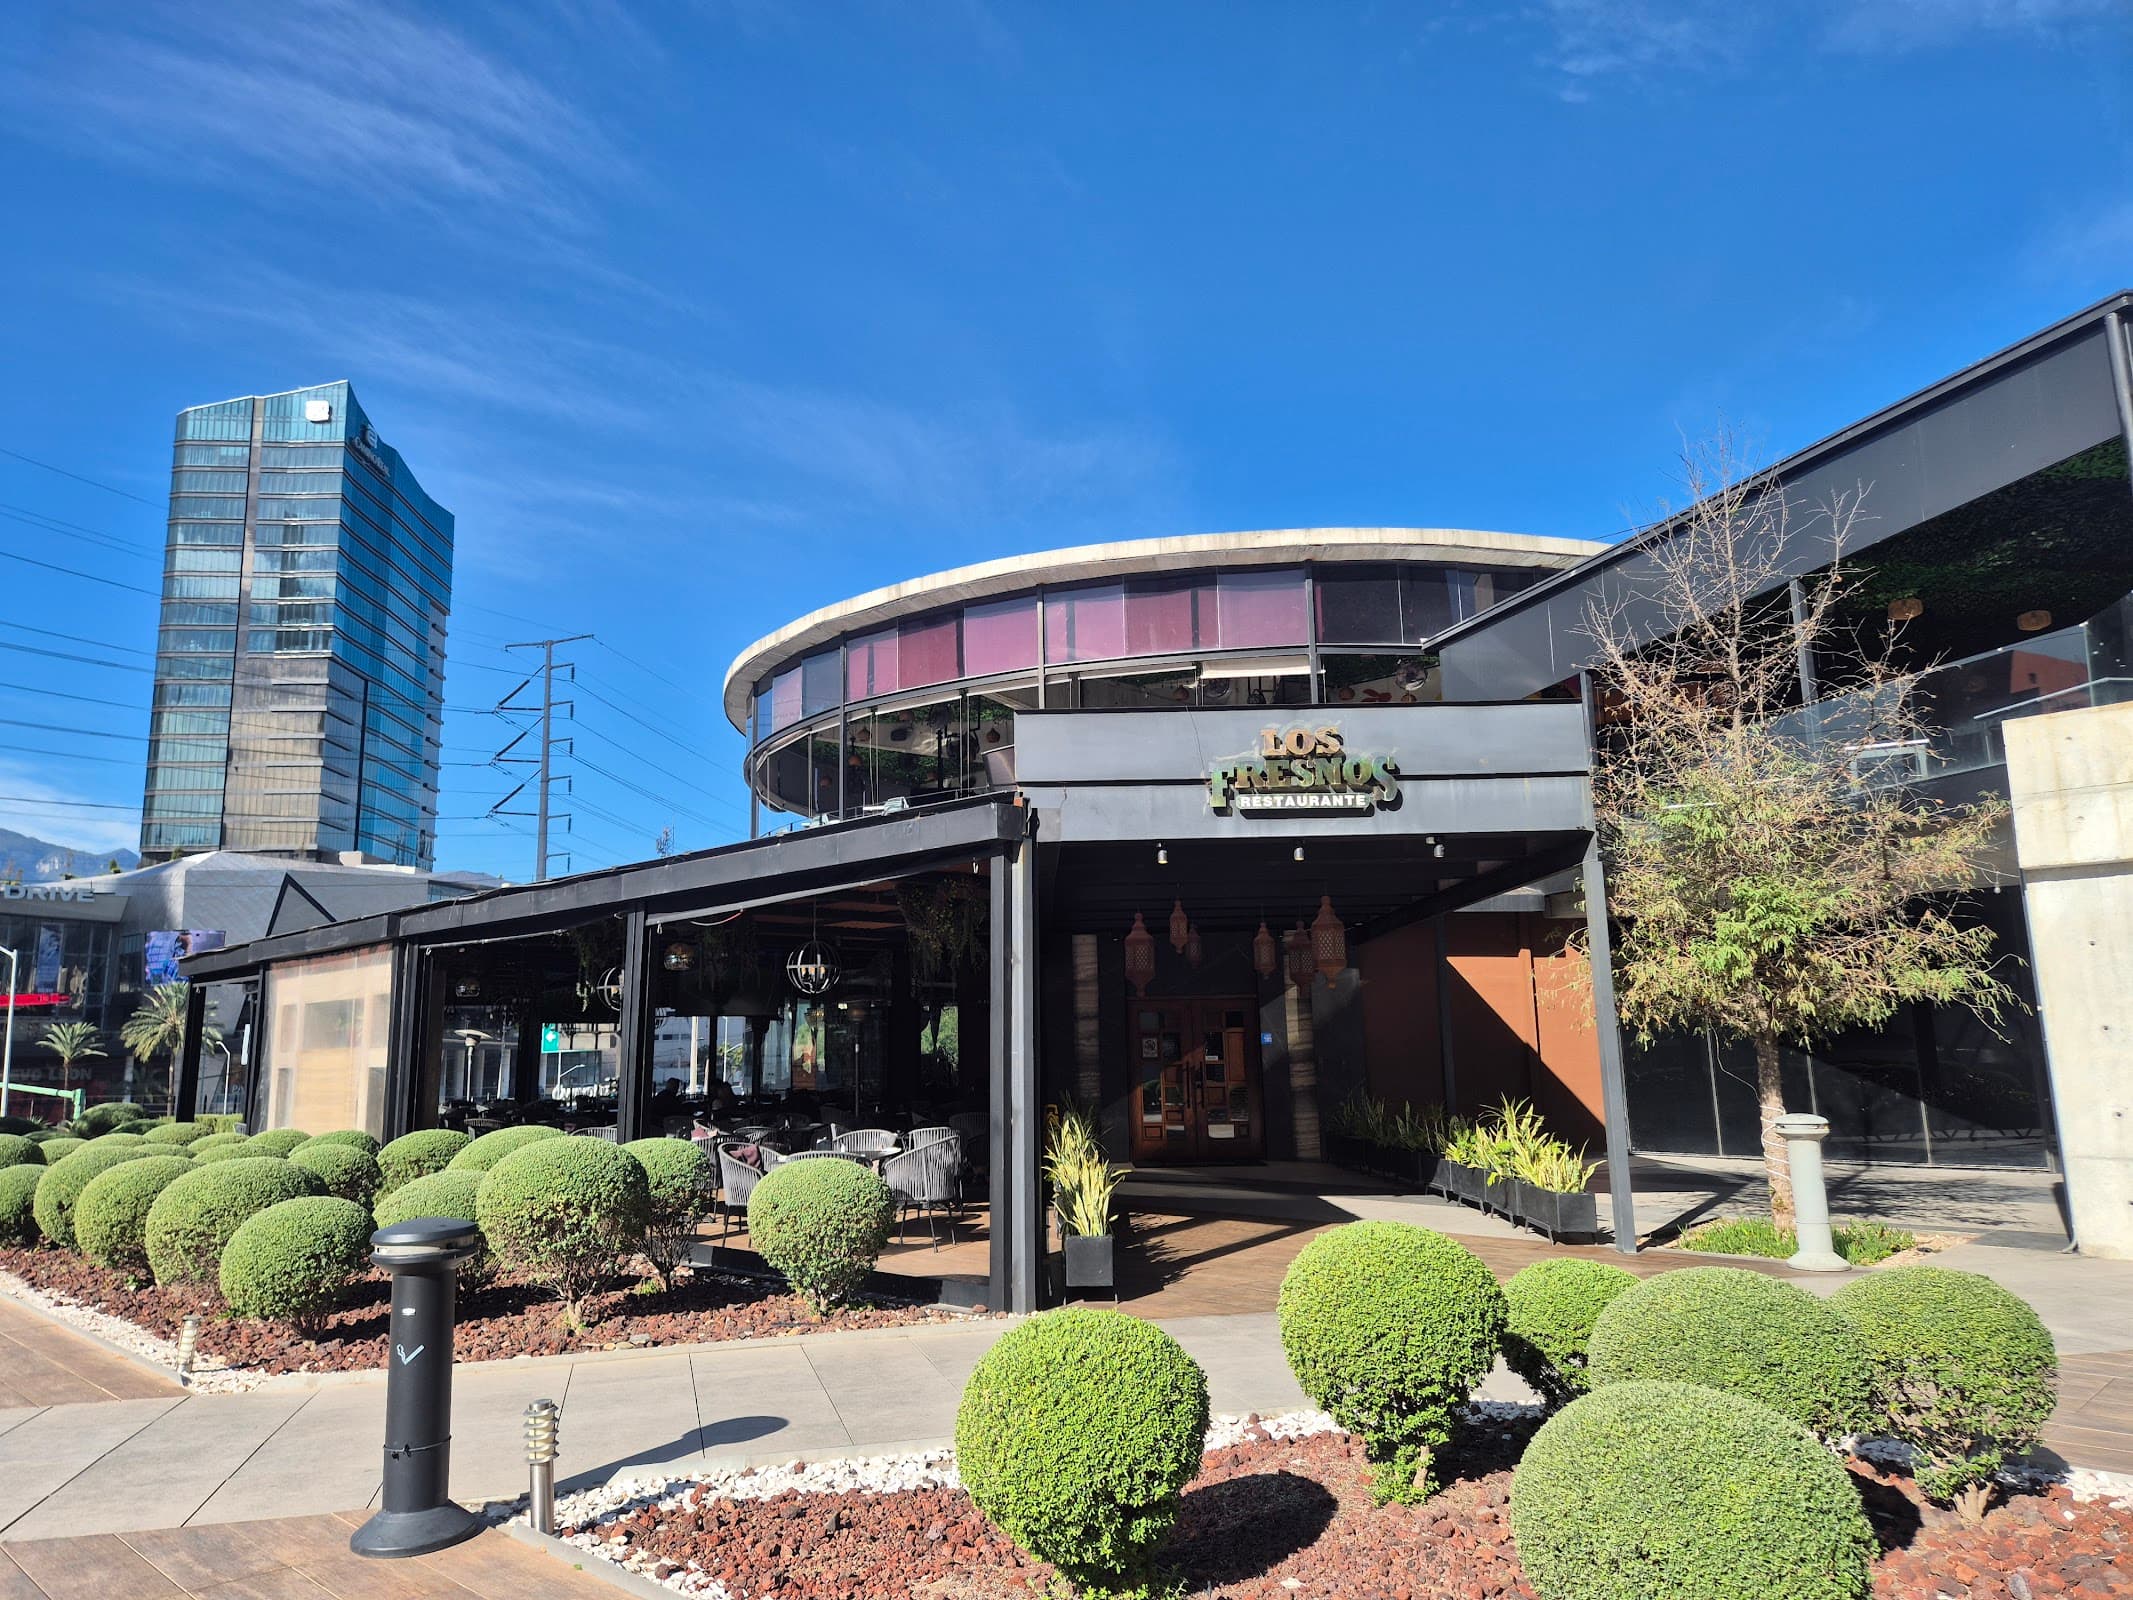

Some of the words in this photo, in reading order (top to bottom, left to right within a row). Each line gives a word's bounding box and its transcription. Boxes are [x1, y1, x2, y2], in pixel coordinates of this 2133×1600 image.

[1261, 726, 1342, 756] LOS
[1209, 756, 1400, 808] FRESNOS
[1240, 794, 1366, 808] RESTAURANTE
[4, 885, 95, 903] DRIVE
